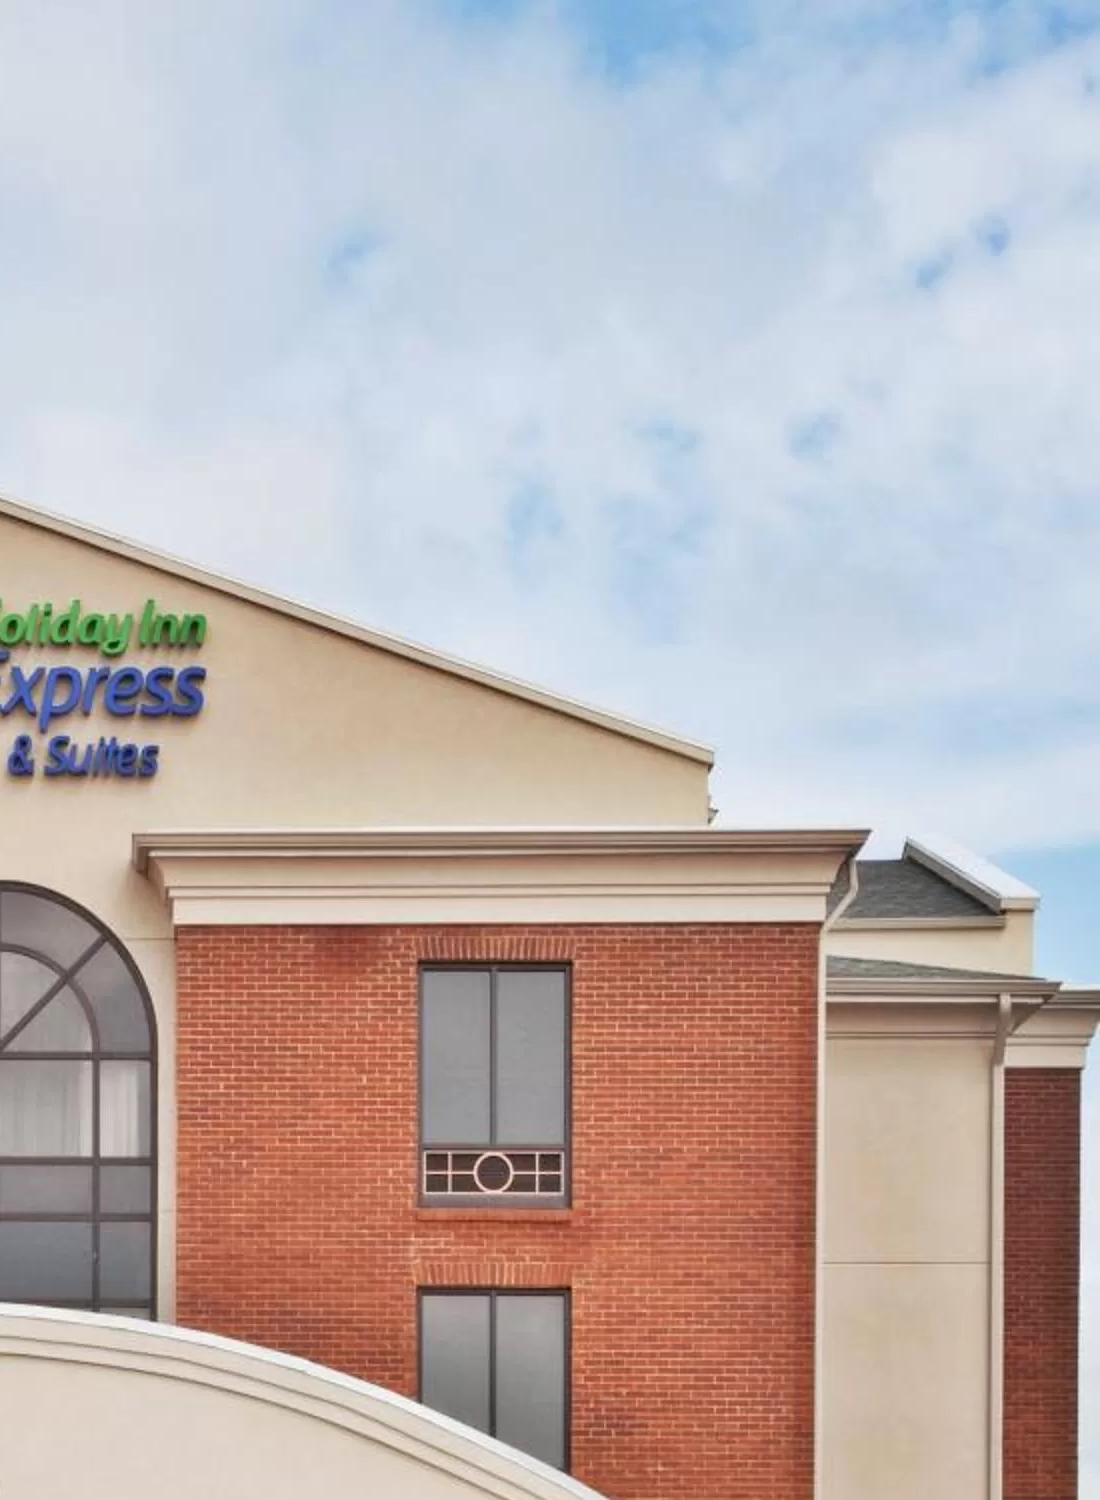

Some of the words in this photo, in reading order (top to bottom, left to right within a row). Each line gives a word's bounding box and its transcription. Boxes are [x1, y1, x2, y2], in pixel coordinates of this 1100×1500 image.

[139, 600, 206, 647] Inn
[8, 735, 33, 776] &
[45, 735, 158, 777] Suites
